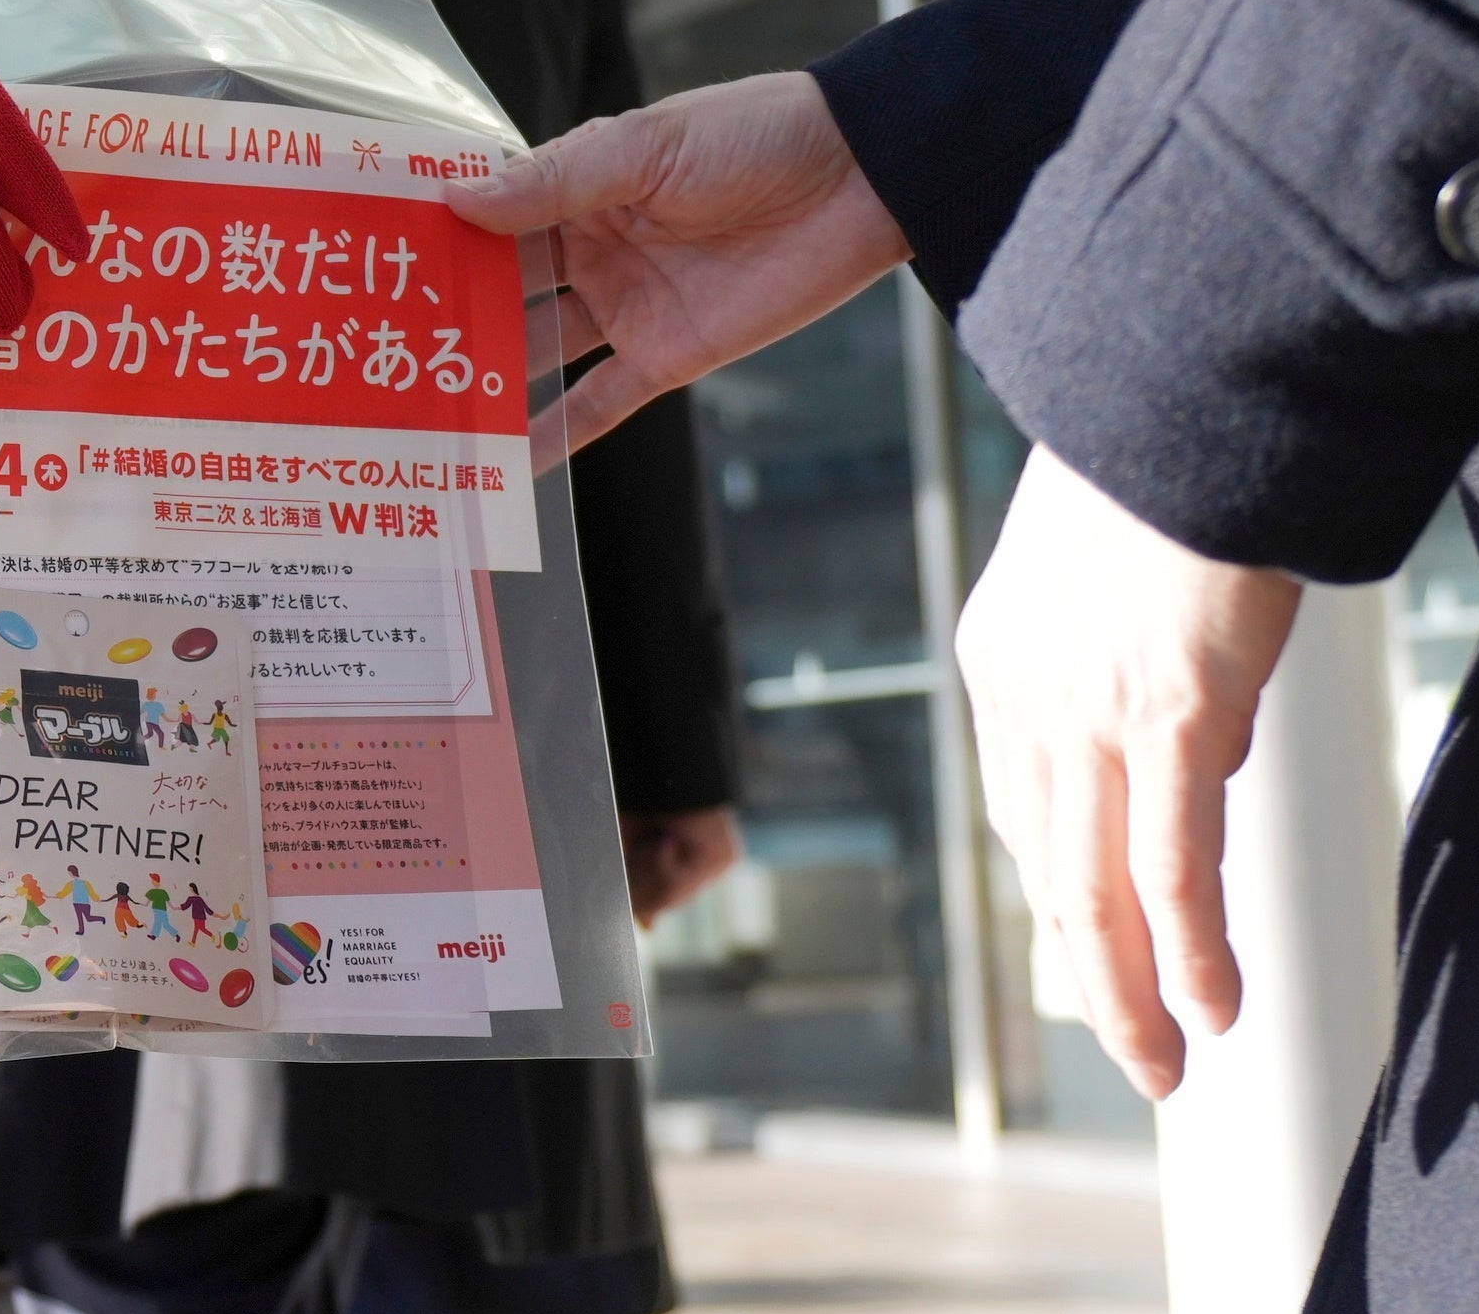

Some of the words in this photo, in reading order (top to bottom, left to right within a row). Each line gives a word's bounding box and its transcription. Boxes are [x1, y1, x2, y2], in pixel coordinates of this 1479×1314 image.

[23, 108, 72, 148] GE
[83, 112, 150, 154] FOR
[160, 121, 210, 160] ALL
[225, 126, 323, 168] JAPAN
[57, 683, 104, 702] meiji
[35, 706, 129, 745] マーブル
[152, 771, 209, 796] 大切な
[261, 799, 426, 812] インをより多くの人に楽しんでほしい」
[14, 818, 205, 865] PARTNER!
[340, 928, 363, 937] YES!
[365, 927, 386, 937] FOR
[343, 941, 397, 952] MARRIAGE
[436, 933, 507, 964] meiji
[345, 956, 394, 966] EQUALITY
